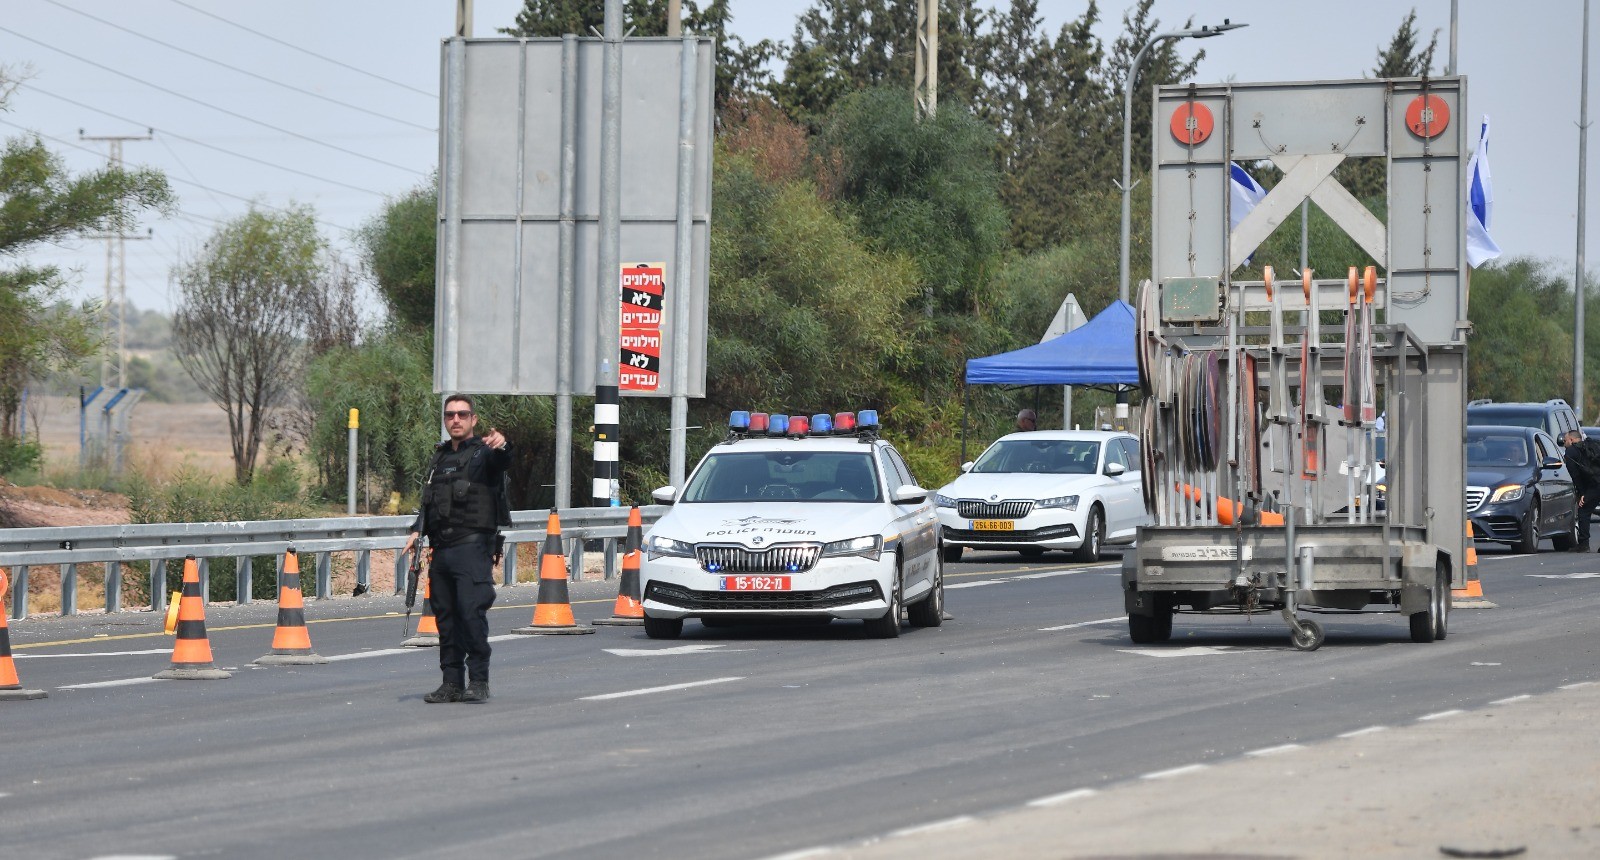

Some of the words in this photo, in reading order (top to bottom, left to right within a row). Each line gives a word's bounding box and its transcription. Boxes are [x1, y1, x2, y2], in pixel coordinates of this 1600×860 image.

[623, 273, 660, 286] חילונים
[631, 292, 652, 307] לא
[622, 312, 660, 324] עבדים
[621, 335, 659, 348] חילונים
[629, 353, 650, 368] לא
[620, 373, 657, 385] עבדים
[706, 527, 759, 537] POLICE
[763, 527, 816, 536] משטרה
